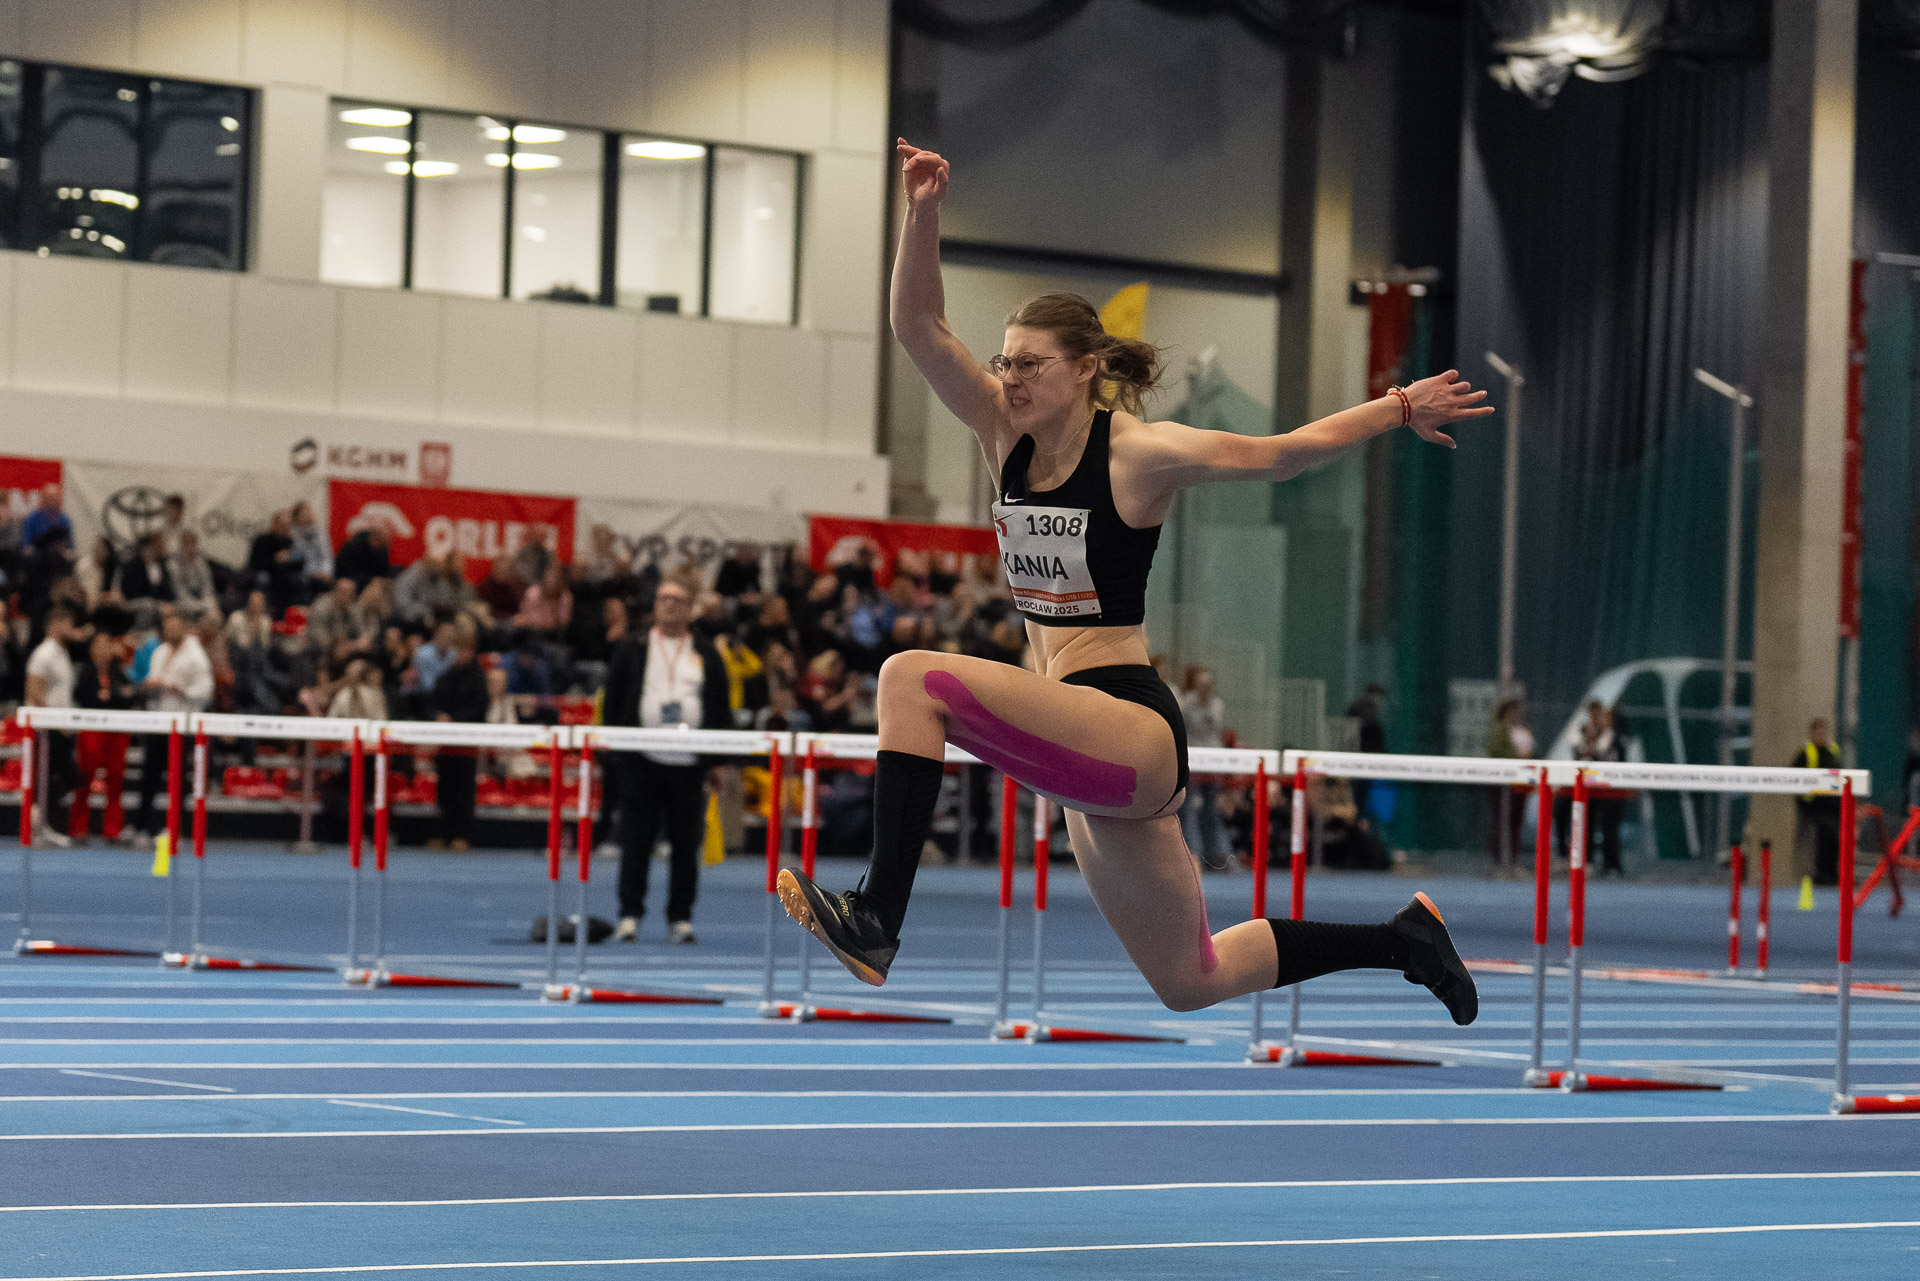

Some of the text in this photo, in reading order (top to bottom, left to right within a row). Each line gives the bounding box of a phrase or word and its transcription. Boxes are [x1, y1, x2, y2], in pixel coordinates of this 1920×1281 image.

[1025, 514, 1083, 537] 1308
[1001, 550, 1070, 580] KANIA
[1016, 600, 1080, 615] ROCŁAW 2025
